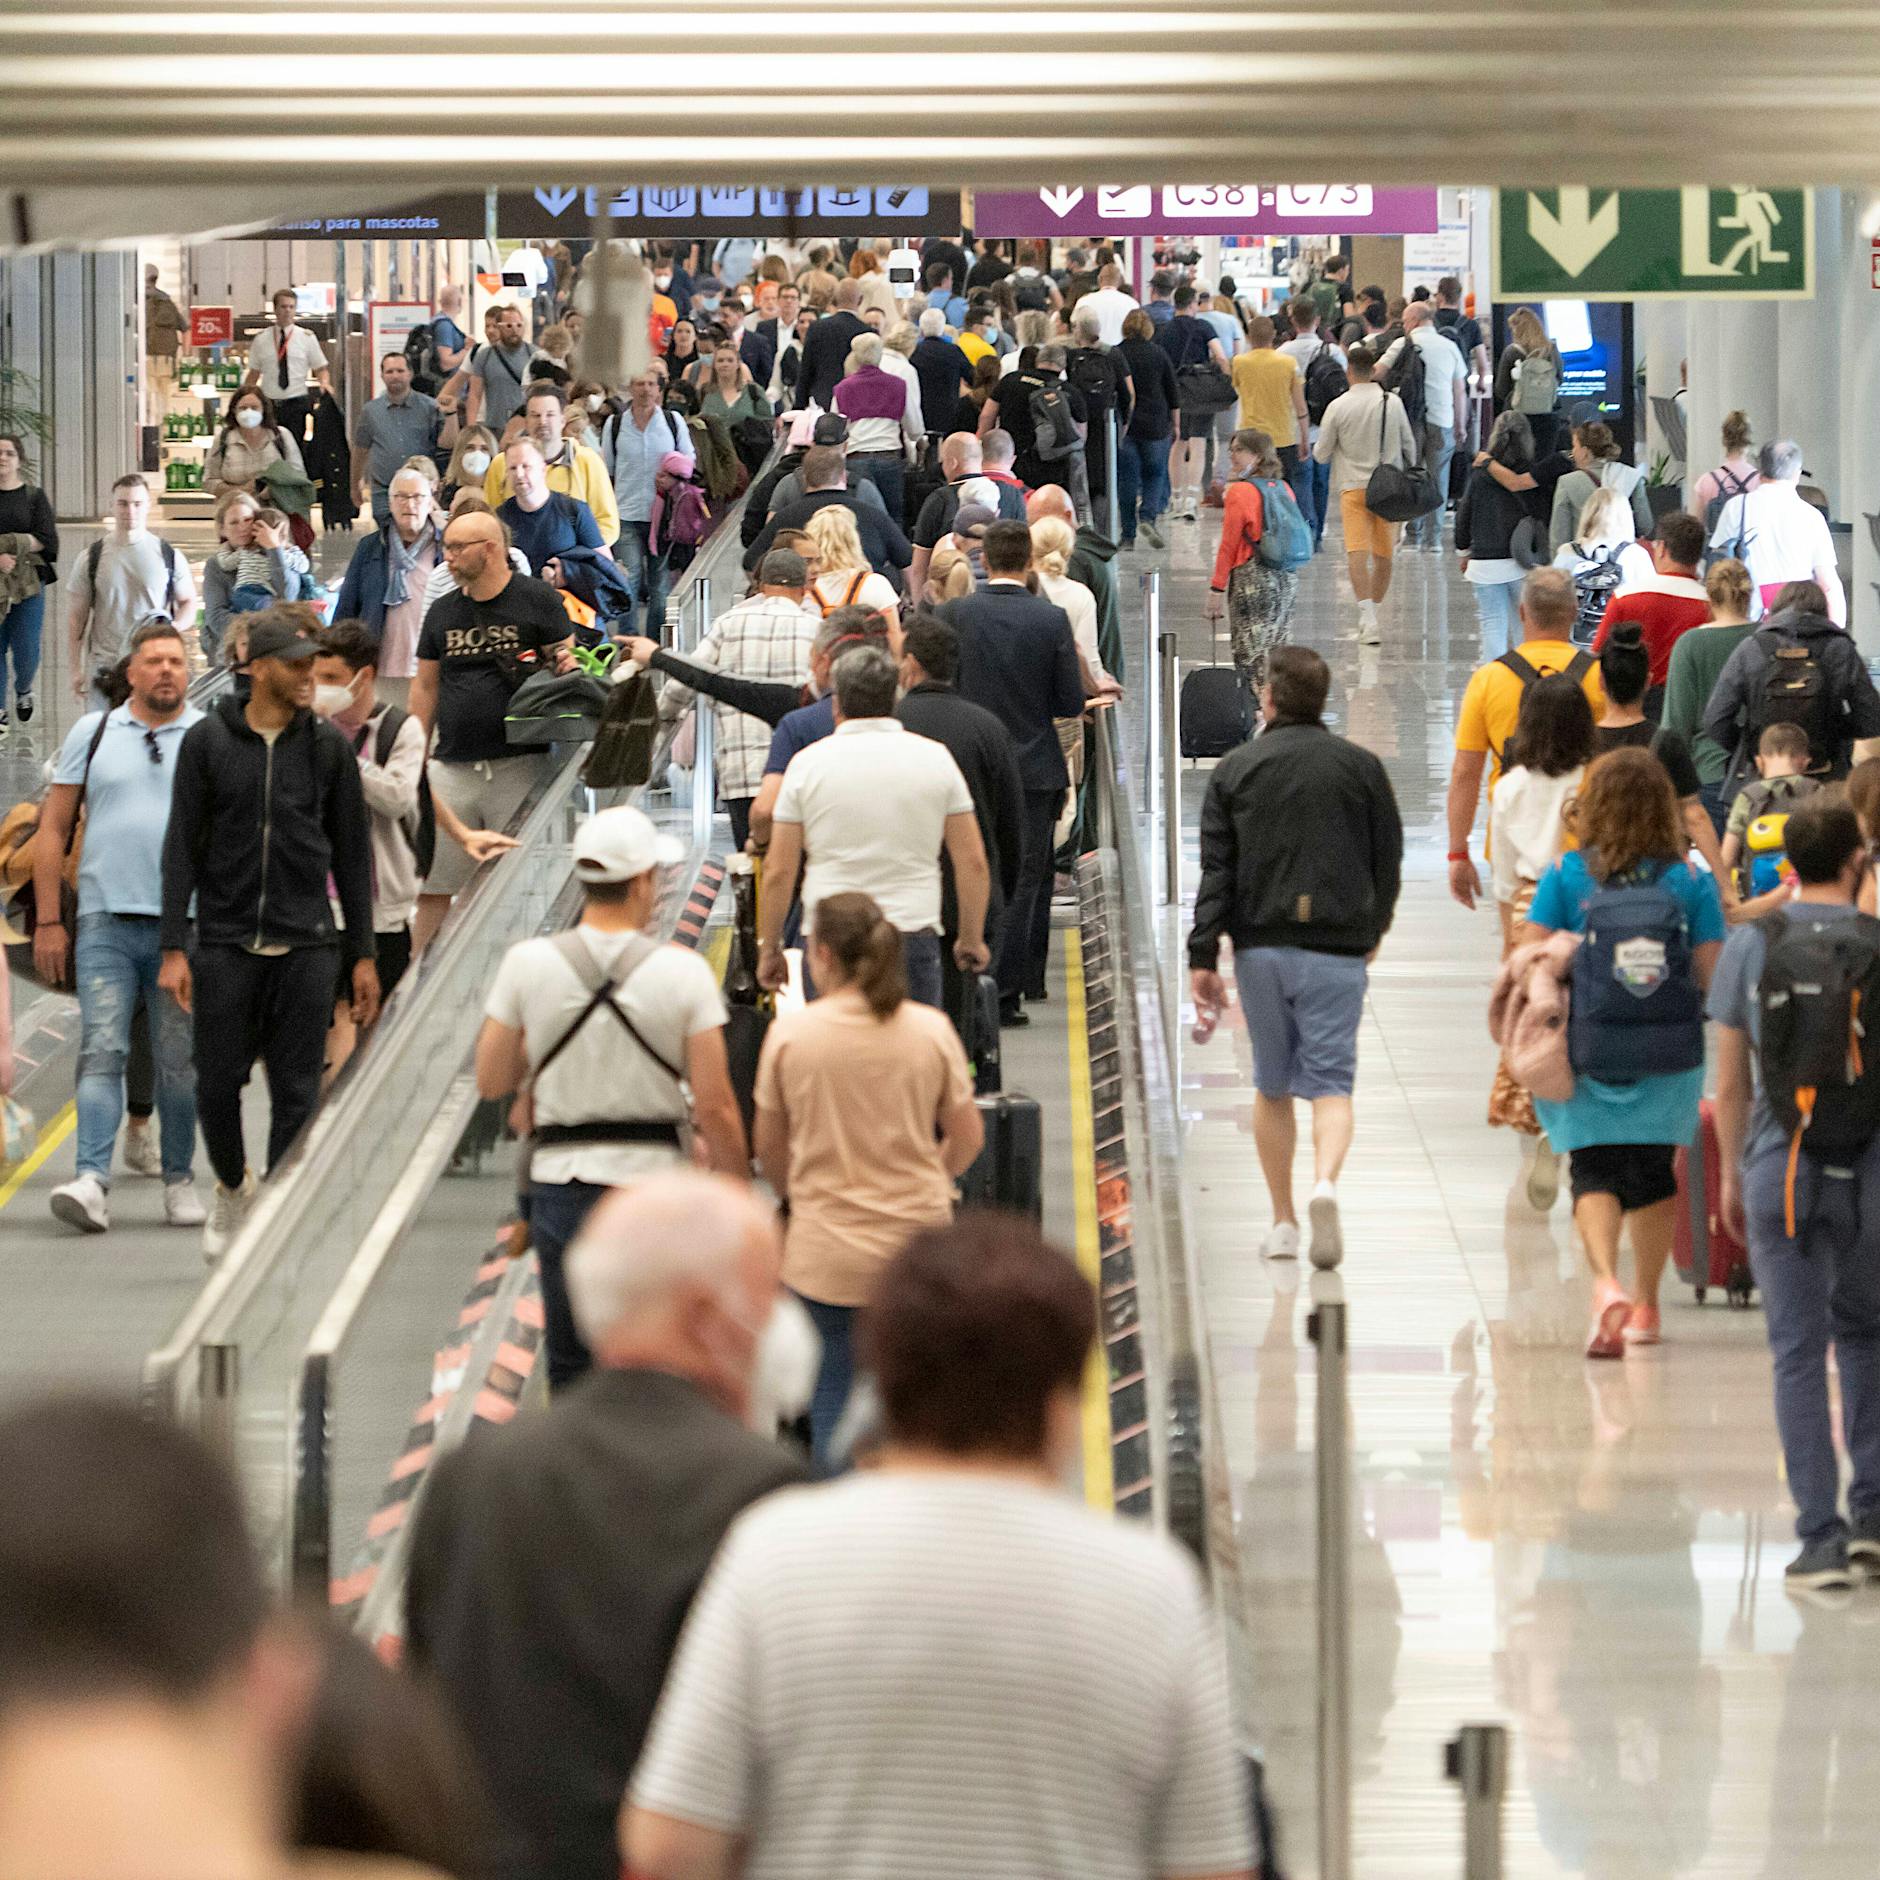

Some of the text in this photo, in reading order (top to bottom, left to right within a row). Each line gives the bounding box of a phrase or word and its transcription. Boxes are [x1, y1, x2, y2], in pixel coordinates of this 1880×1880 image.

[325, 218, 361, 232] para
[365, 216, 439, 230] mascotas
[446, 624, 519, 649] BOSS
